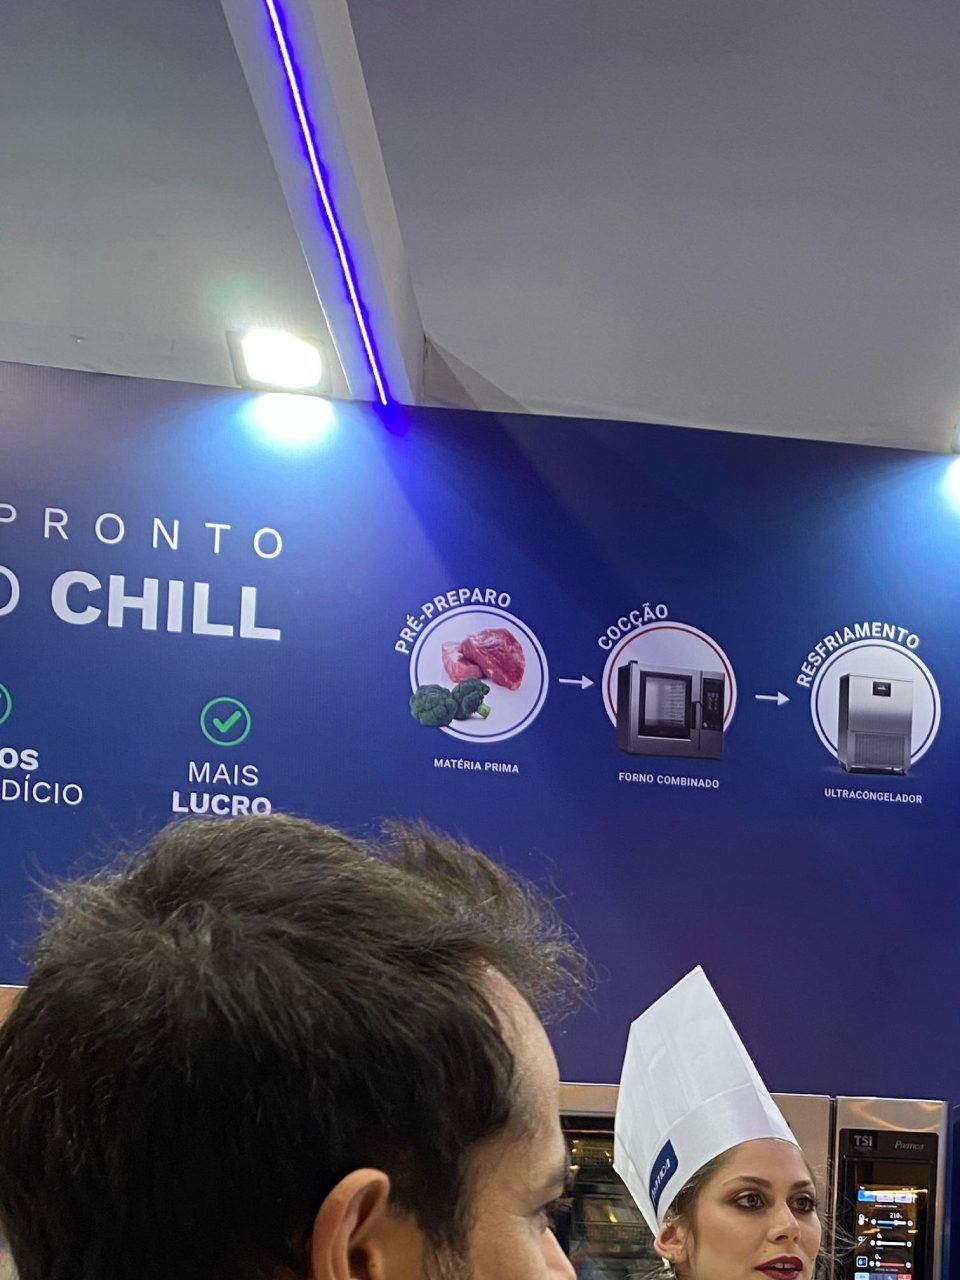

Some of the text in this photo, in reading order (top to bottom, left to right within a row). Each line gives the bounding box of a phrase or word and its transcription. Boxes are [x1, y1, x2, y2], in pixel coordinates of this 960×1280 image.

[51, 571, 281, 641] CHILL
[394, 587, 511, 655] PRÉ-PREPARO
[597, 602, 669, 651] COCÇÃO
[796, 621, 920, 688] RESFRIAMENTO
[188, 761, 259, 787] MAIS
[434, 757, 520, 774] MATÉRIA PRIMA
[618, 772, 720, 789] FORNO COMBINADO
[172, 791, 272, 817] LUCRO
[824, 788, 923, 804] ULTRACONGELADOR
